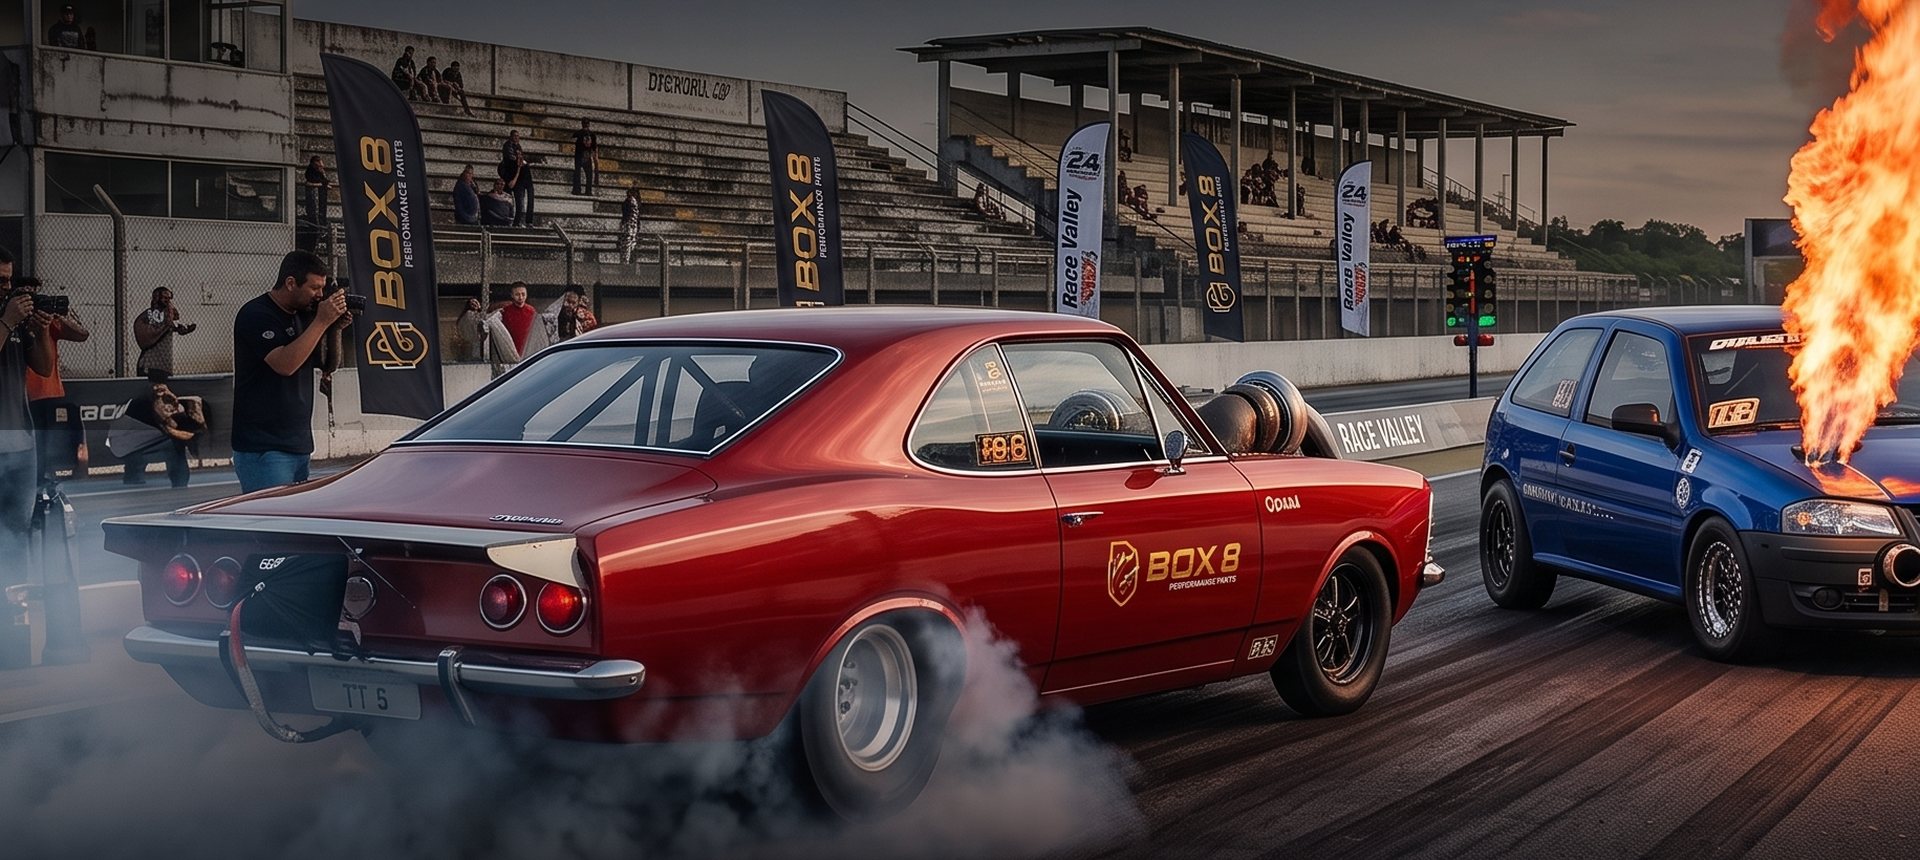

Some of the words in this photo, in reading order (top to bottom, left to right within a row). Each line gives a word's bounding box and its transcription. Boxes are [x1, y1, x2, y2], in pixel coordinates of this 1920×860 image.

[360, 136, 392, 174] 8
[787, 153, 812, 184] 8
[1198, 175, 1216, 197] 8
[1342, 184, 1367, 201] 24
[789, 188, 820, 292] BOX
[1062, 187, 1082, 249] Valley
[1201, 201, 1224, 275] BOX
[363, 180, 406, 310] BOX
[1062, 255, 1078, 309] Race
[1146, 545, 1218, 582] BOX
[1221, 542, 1241, 573] 8
